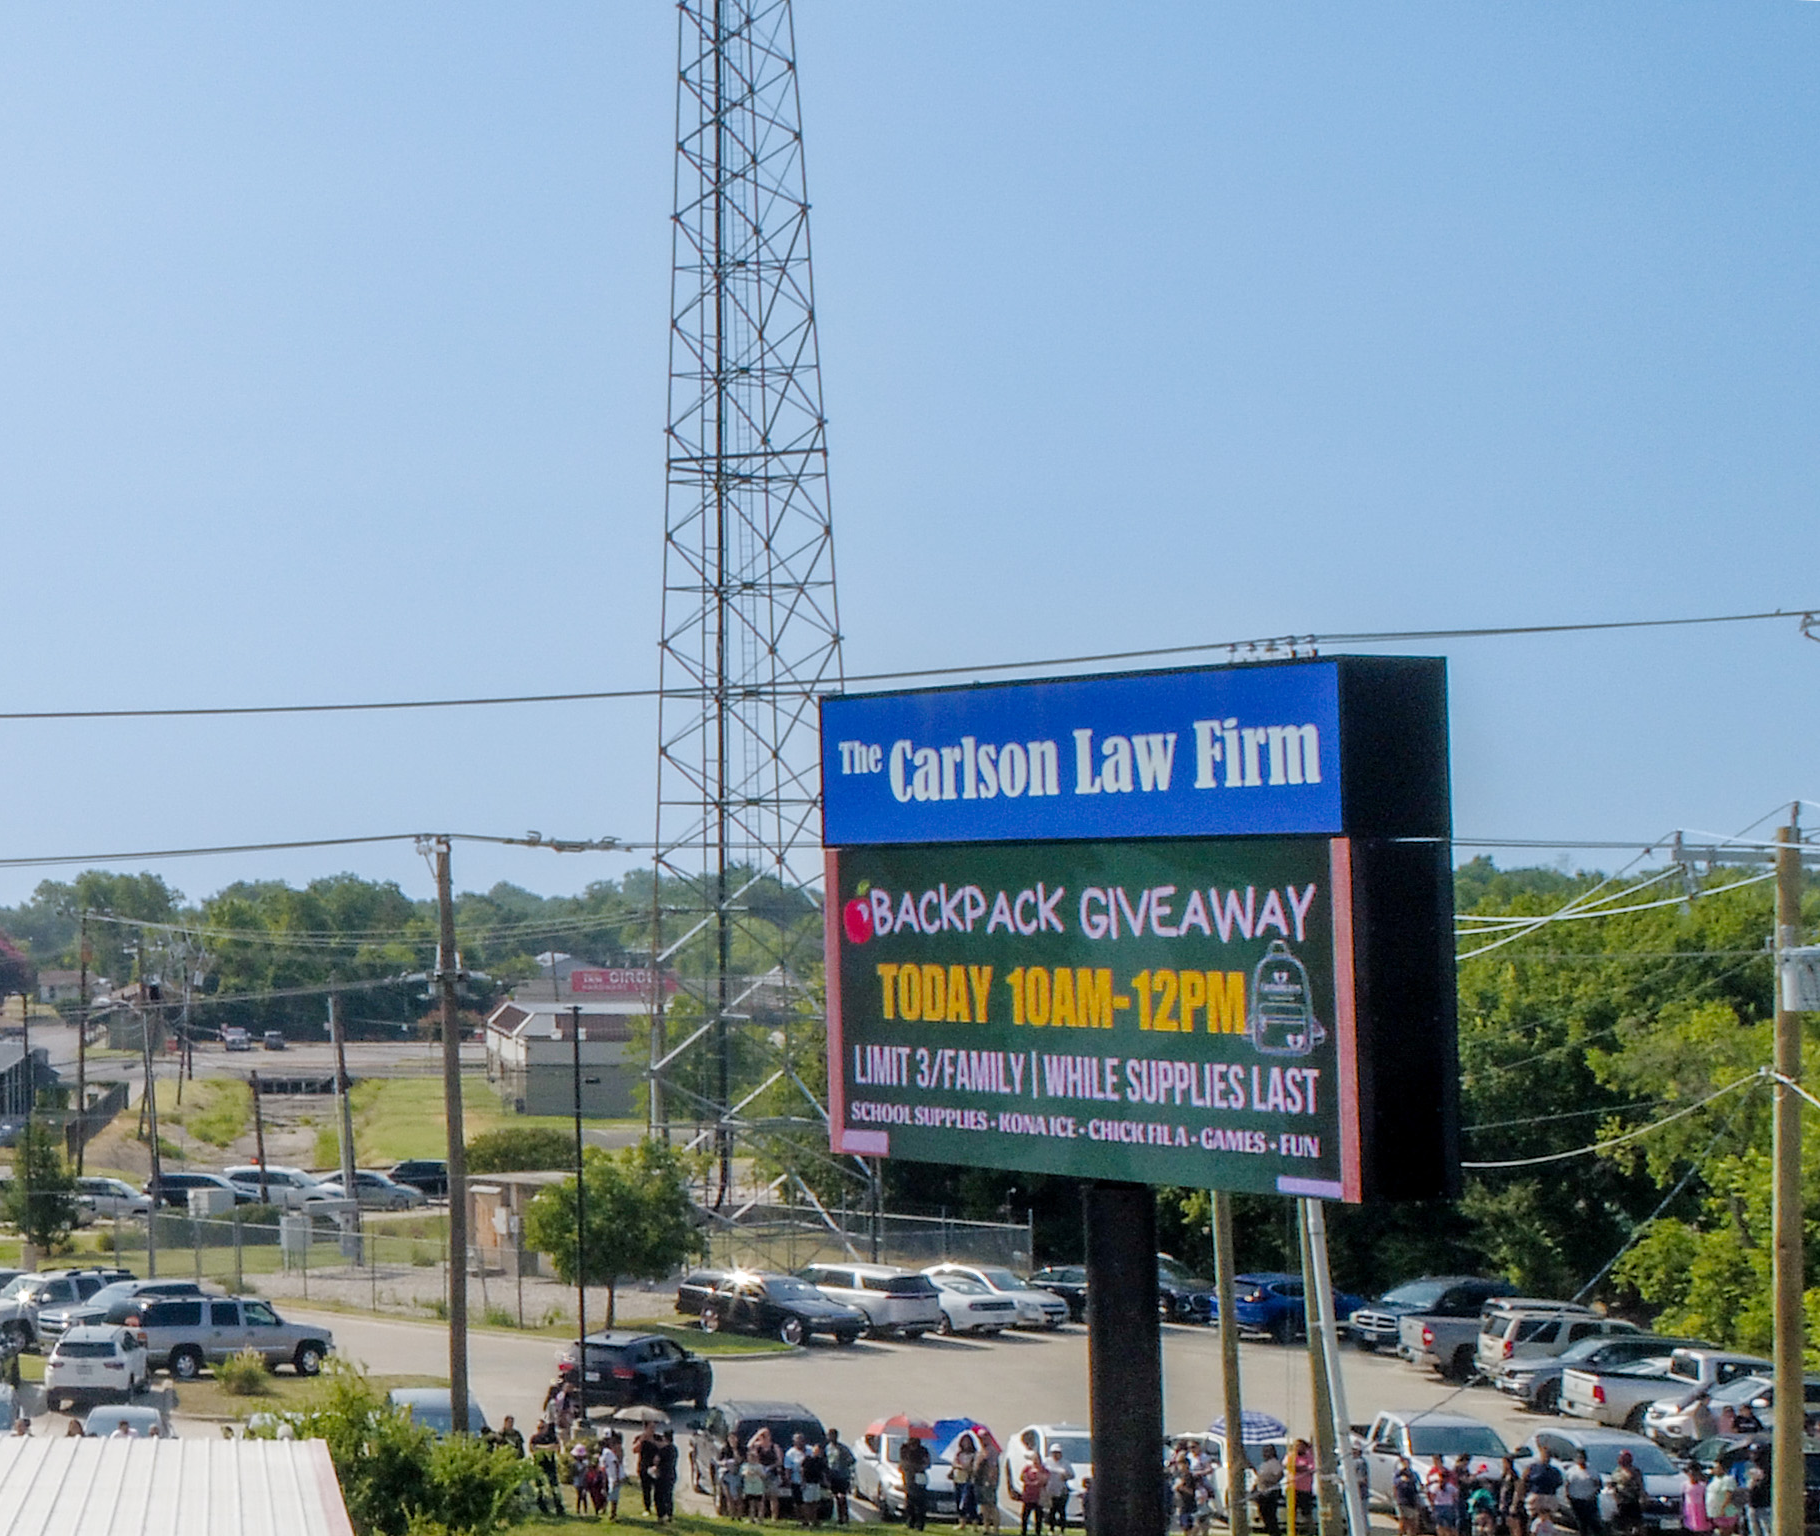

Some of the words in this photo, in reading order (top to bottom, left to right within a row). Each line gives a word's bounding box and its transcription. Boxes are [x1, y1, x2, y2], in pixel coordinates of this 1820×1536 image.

[839, 740, 882, 775] The
[889, 736, 1060, 802] Carlson
[1073, 728, 1177, 795] Law
[1193, 717, 1322, 789] Firm
[870, 882, 1065, 937] BACKPACK
[1079, 883, 1316, 943] GIVEAWAY
[877, 963, 993, 1024] TODAY
[1005, 966, 1247, 1035] 10AM-12PM
[854, 1044, 911, 1087] LIMIT
[916, 1047, 1025, 1094] 3/FAMILY
[1043, 1054, 1121, 1101] WHILE
[1126, 1058, 1246, 1110] SUPPLIES
[1252, 1065, 1320, 1115] LAST
[851, 1101, 913, 1124] SCHOOL
[914, 1106, 988, 1130] SUPPLIES
[999, 1113, 1049, 1136] KONA
[1050, 1116, 1078, 1138] ICE
[1088, 1118, 1146, 1144] CHICK
[1200, 1127, 1266, 1154] GAMES
[1280, 1134, 1321, 1158] FUN
